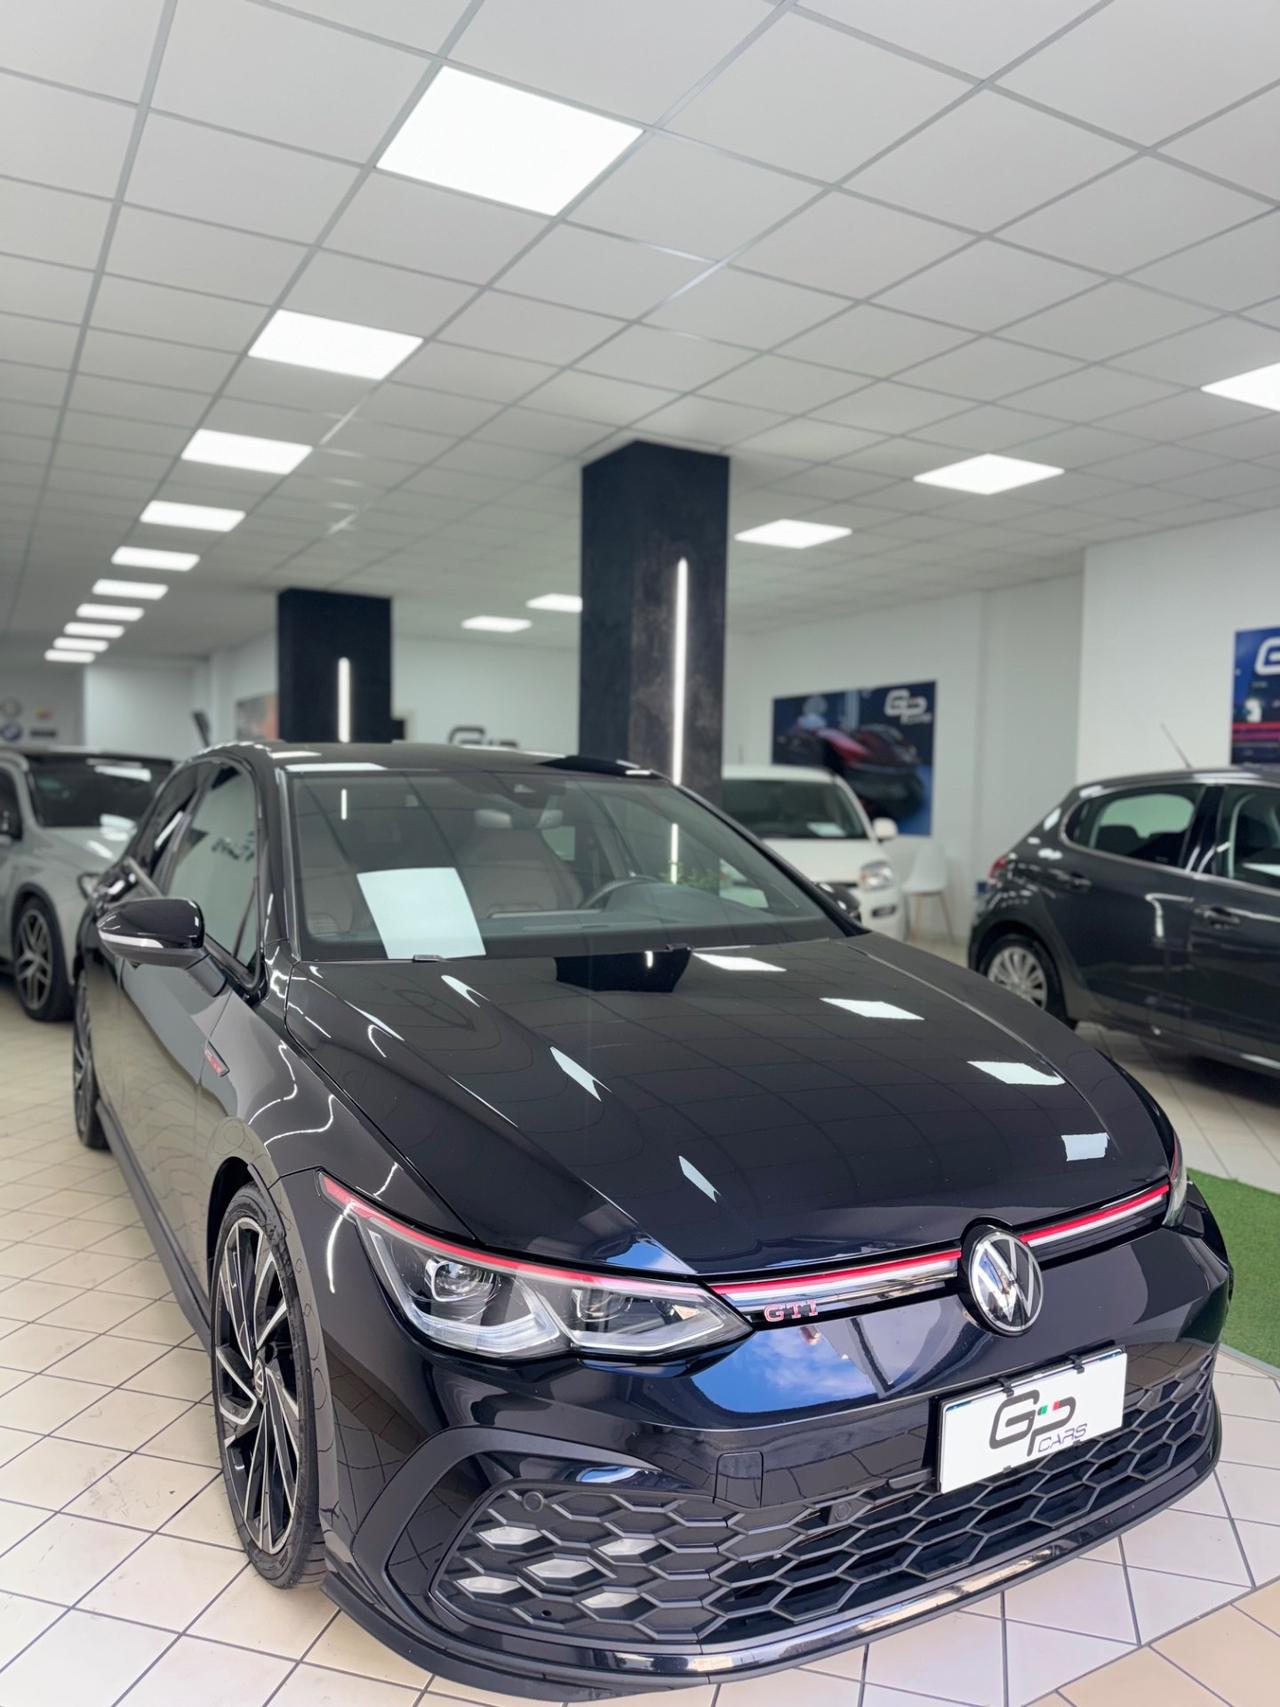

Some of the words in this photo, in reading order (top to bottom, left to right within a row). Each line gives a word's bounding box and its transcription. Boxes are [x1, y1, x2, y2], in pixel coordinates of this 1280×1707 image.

[764, 1299, 818, 1322] GTI
[989, 1389, 1076, 1457] GP
[1038, 1423, 1087, 1452] CARS
